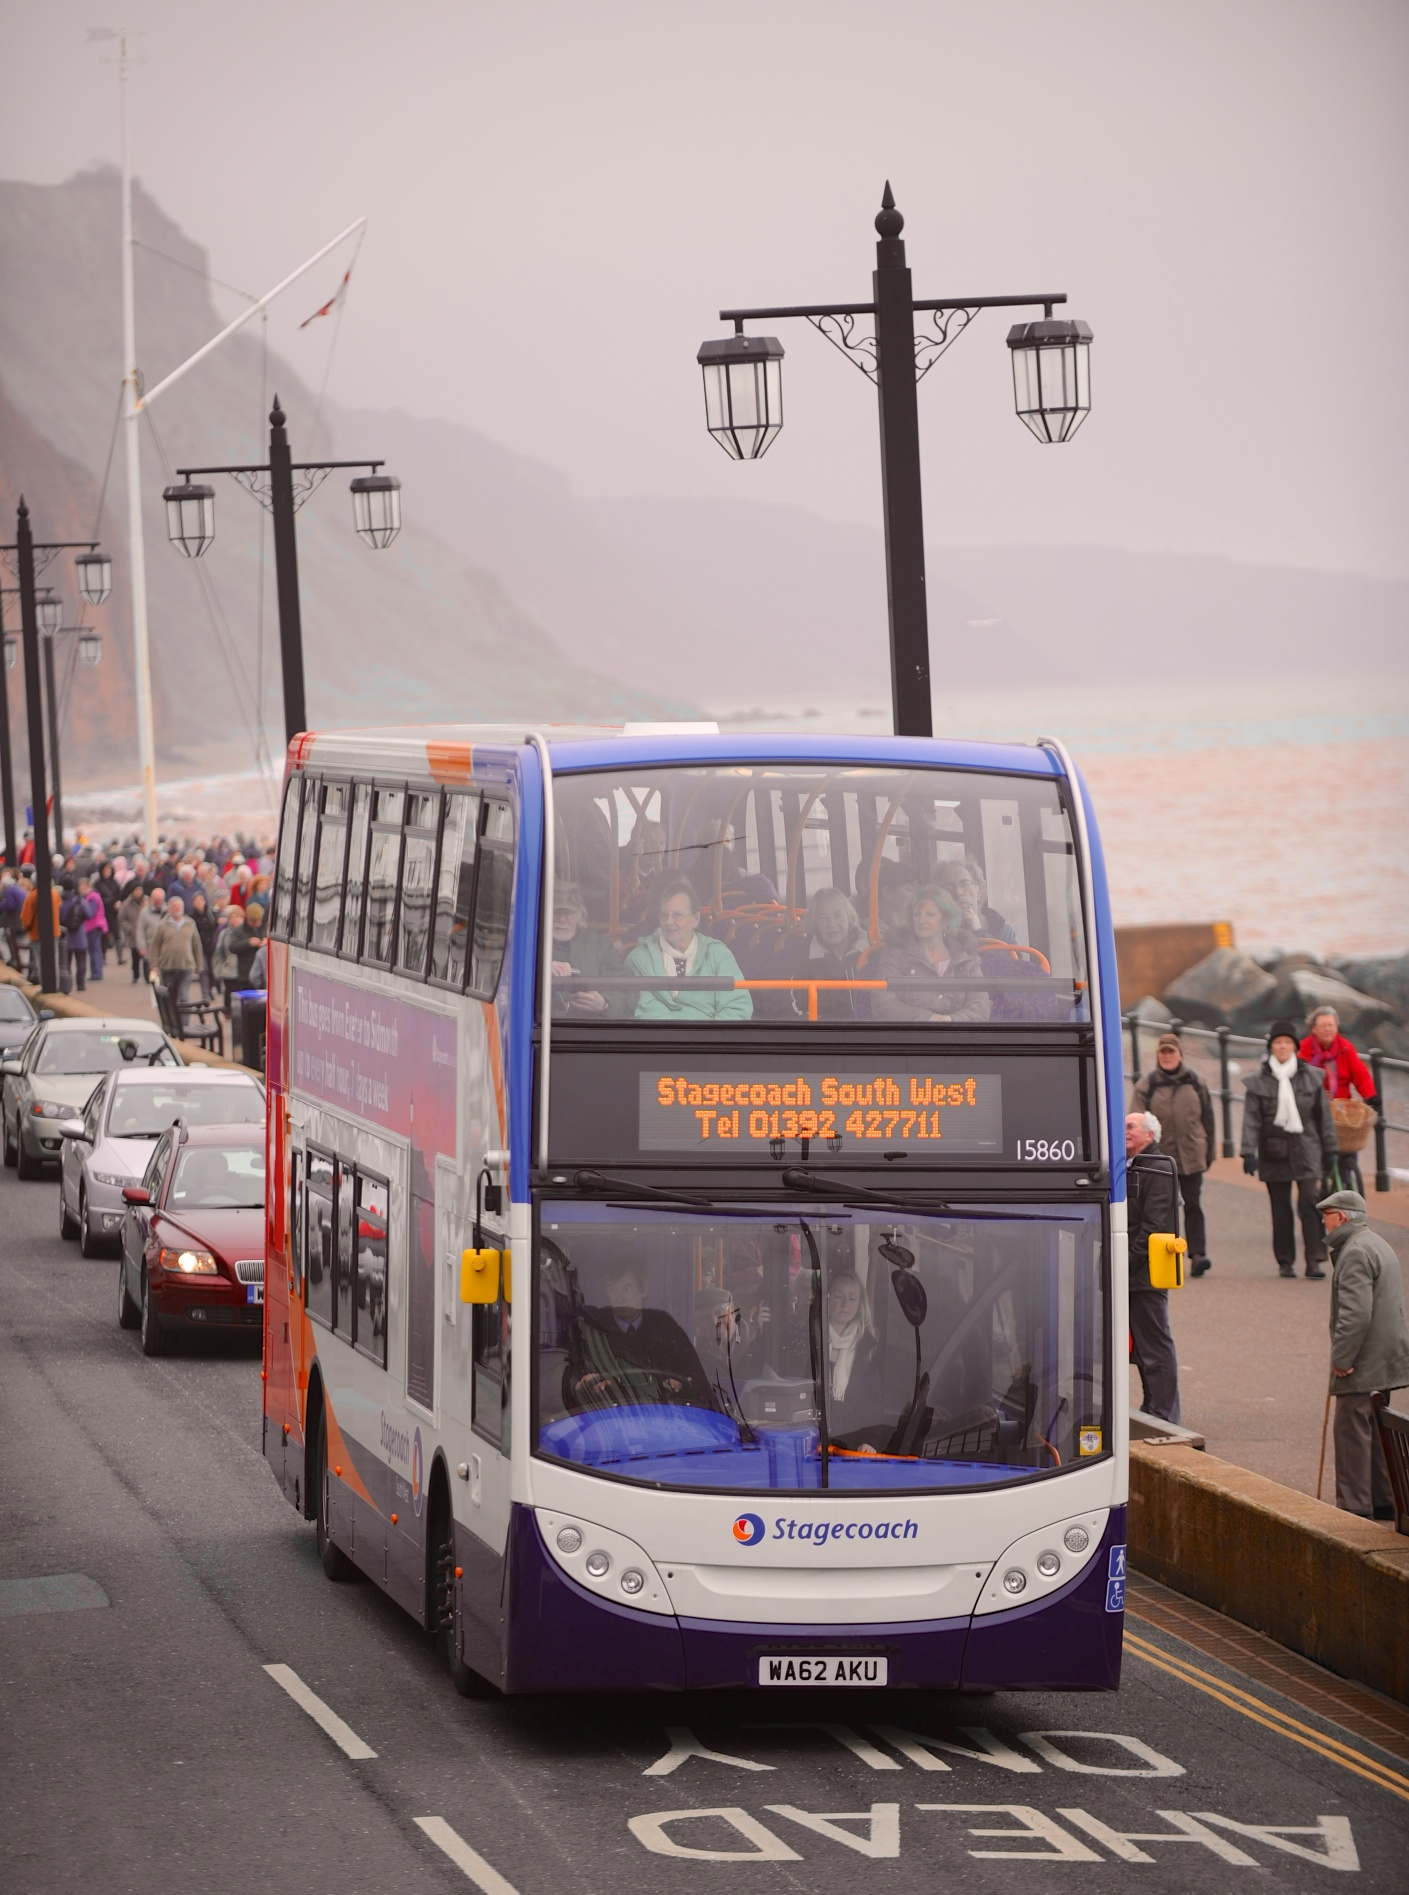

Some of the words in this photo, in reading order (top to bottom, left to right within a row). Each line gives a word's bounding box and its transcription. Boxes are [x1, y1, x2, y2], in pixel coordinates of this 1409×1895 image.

[308, 989, 318, 1029] bus
[657, 1076, 812, 1107] Stagecoach
[821, 1077, 900, 1107] South
[910, 1077, 977, 1107] West
[694, 1110, 740, 1139] Tel
[749, 1110, 837, 1139] 01392
[845, 1110, 943, 1139] 427711
[1016, 1139, 1076, 1161] 15860
[381, 1409, 410, 1465] Stagecoach
[772, 1517, 920, 1547] Stagecoach
[769, 1660, 828, 1681] WA62
[834, 1660, 878, 1681] AKU
[641, 1723, 1188, 1779] ONLY
[626, 1802, 1362, 1872] AHEAD
